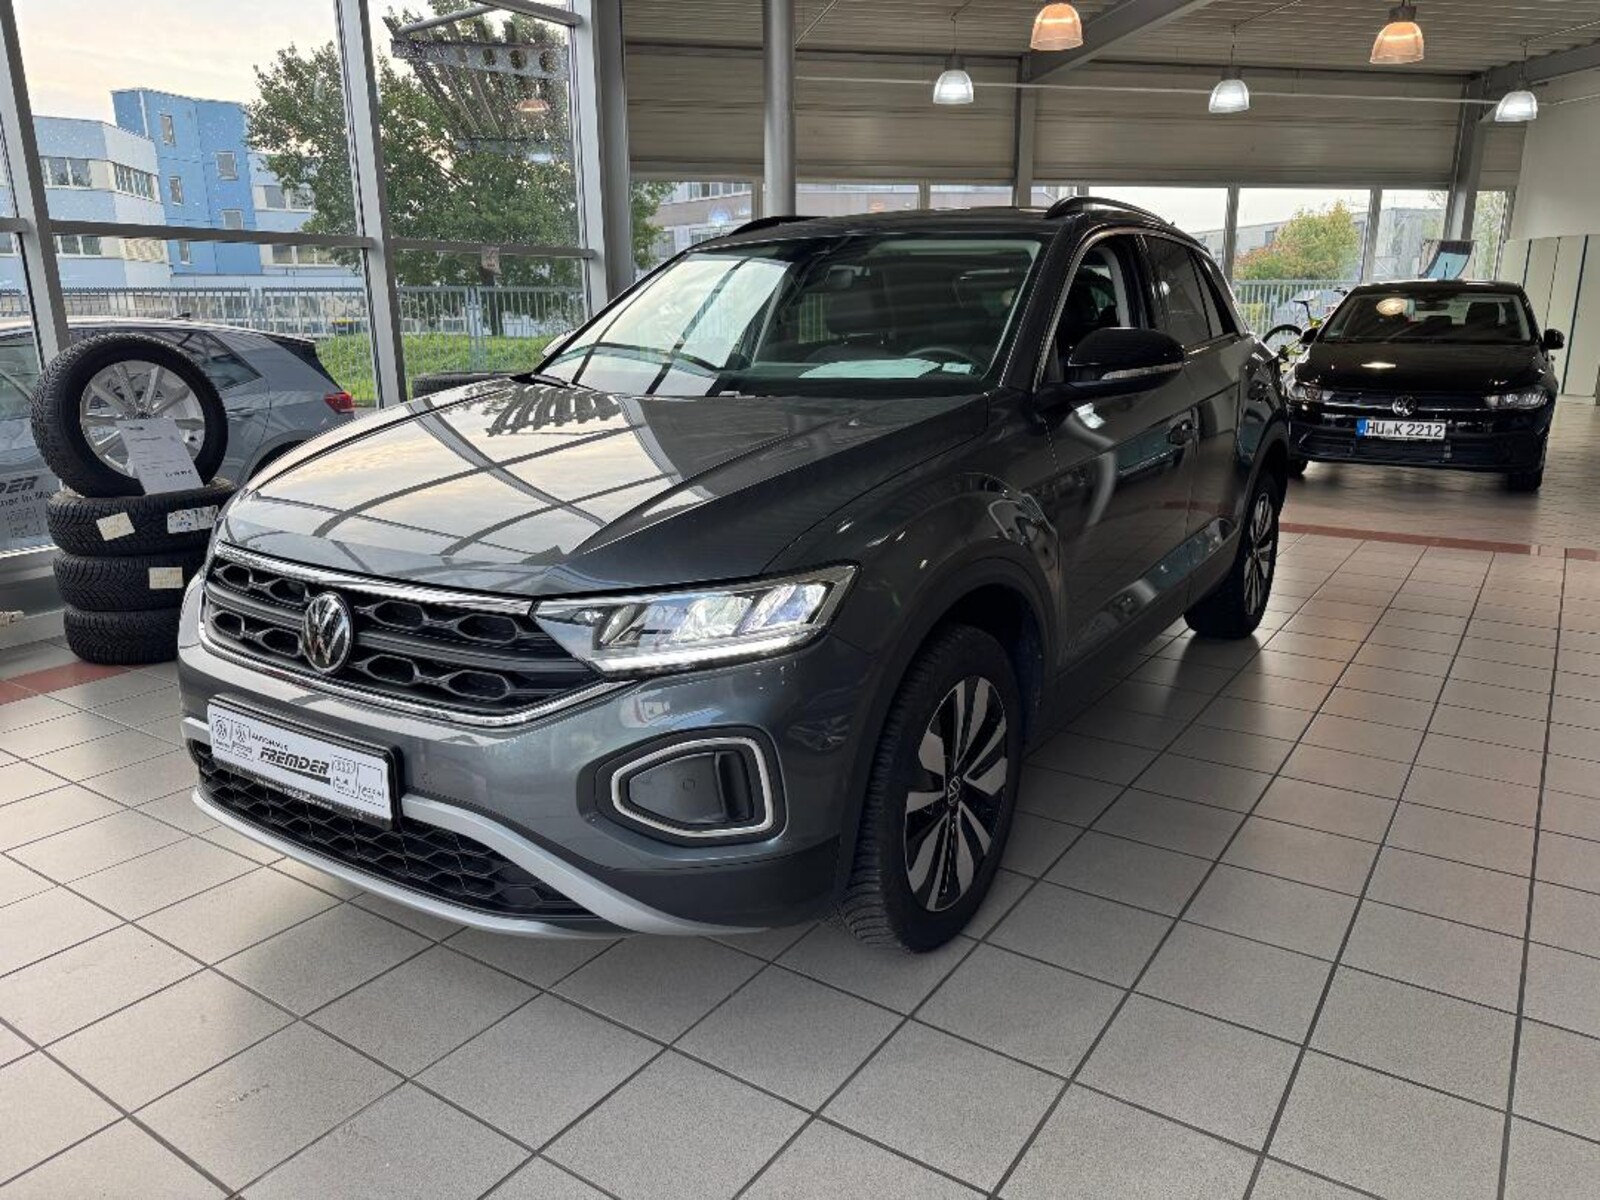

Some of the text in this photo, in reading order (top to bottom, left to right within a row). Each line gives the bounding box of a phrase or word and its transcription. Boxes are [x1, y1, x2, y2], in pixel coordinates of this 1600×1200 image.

[1366, 421, 1443, 438] HU K 2212
[260, 746, 330, 775] FREMDER
